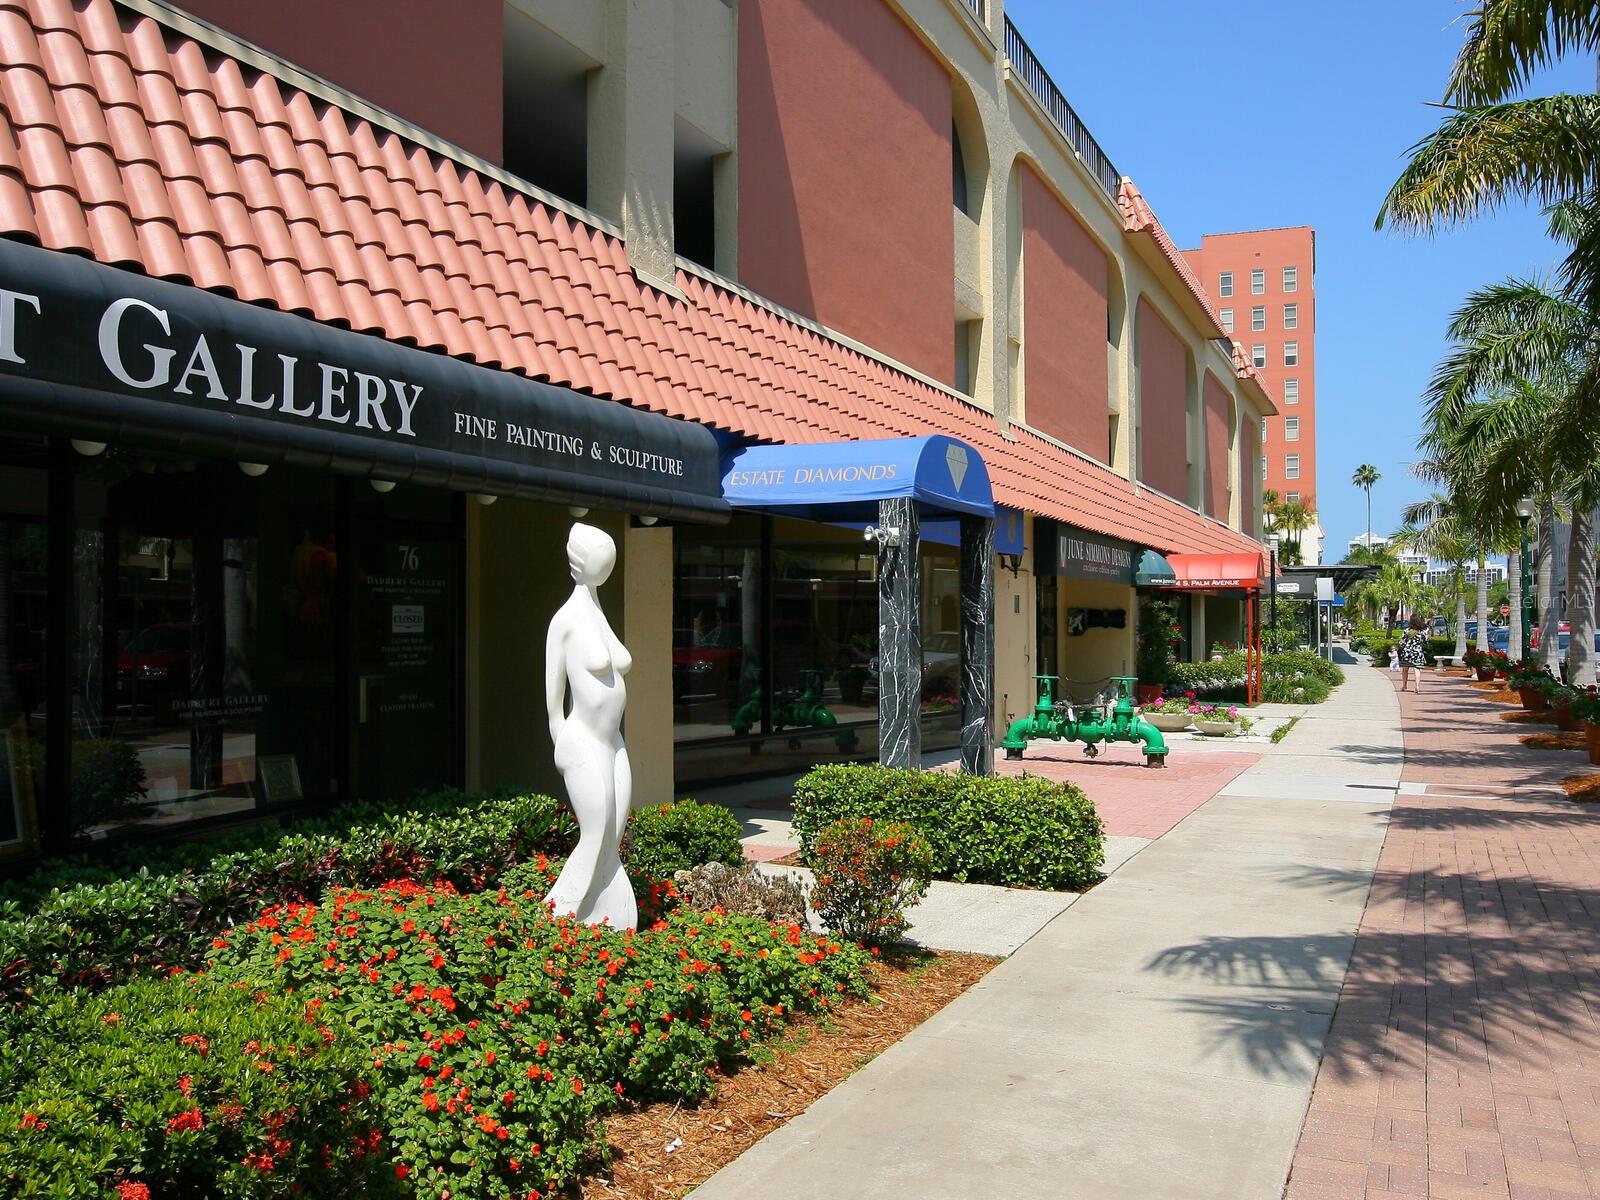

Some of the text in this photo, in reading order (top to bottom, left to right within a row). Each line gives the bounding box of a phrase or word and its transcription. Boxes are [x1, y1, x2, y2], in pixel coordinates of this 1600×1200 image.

[98, 297, 424, 437] GALLERY
[454, 412, 684, 477] FINE PAINTING & SCULPTURE
[730, 463, 897, 486] ESTATE DIAMONDS
[398, 545, 419, 571] 76
[1067, 538, 1132, 569] JUNE SIMMONS DESIGNS
[393, 615, 424, 624] CLOSED
[225, 694, 269, 705] GALLERY
